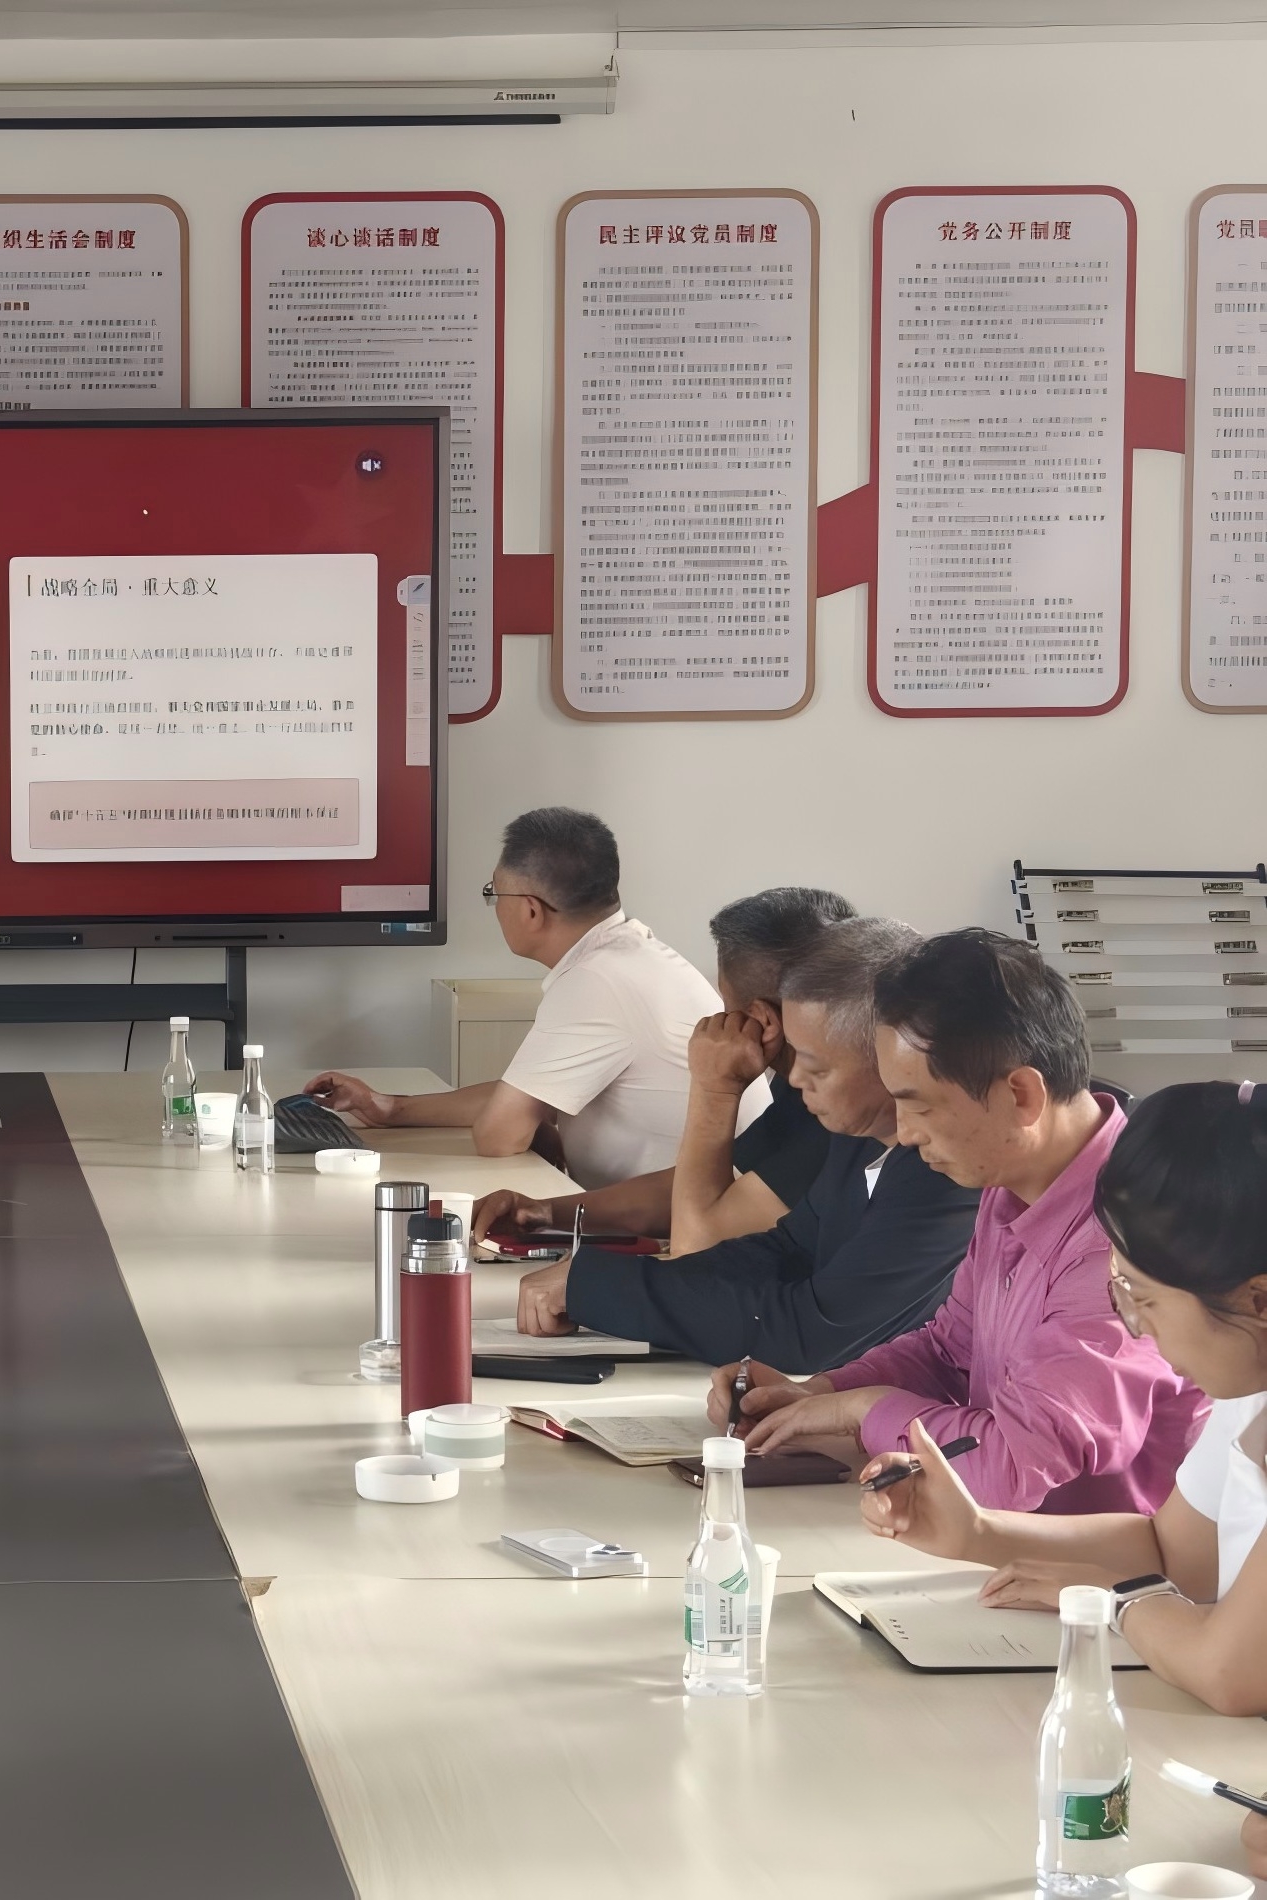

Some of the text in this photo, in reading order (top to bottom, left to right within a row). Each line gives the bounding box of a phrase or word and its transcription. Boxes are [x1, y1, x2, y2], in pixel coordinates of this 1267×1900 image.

[306, 226, 440, 248] 谈心谈话制度
[599, 223, 778, 245] 民主评议党员制度
[937, 220, 1072, 242] 党务公开制度
